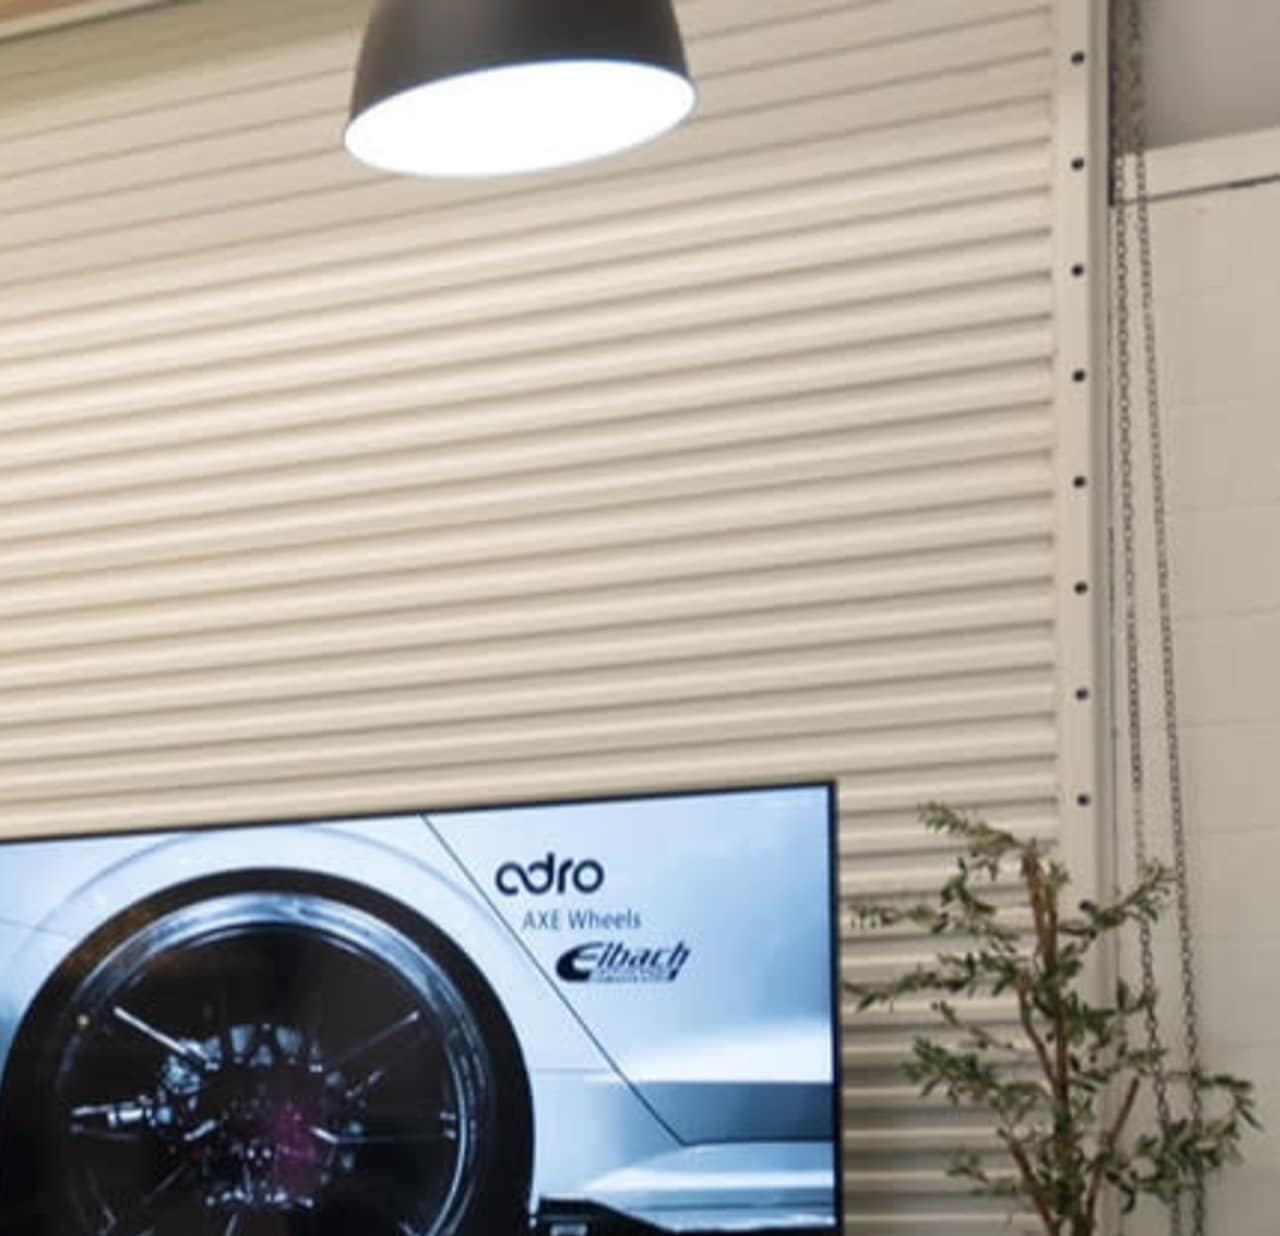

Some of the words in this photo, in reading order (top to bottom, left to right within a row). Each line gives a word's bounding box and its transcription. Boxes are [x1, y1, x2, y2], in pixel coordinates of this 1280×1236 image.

[495, 852, 604, 895] adro
[523, 908, 560, 930] AXE
[568, 906, 642, 930] Wheels
